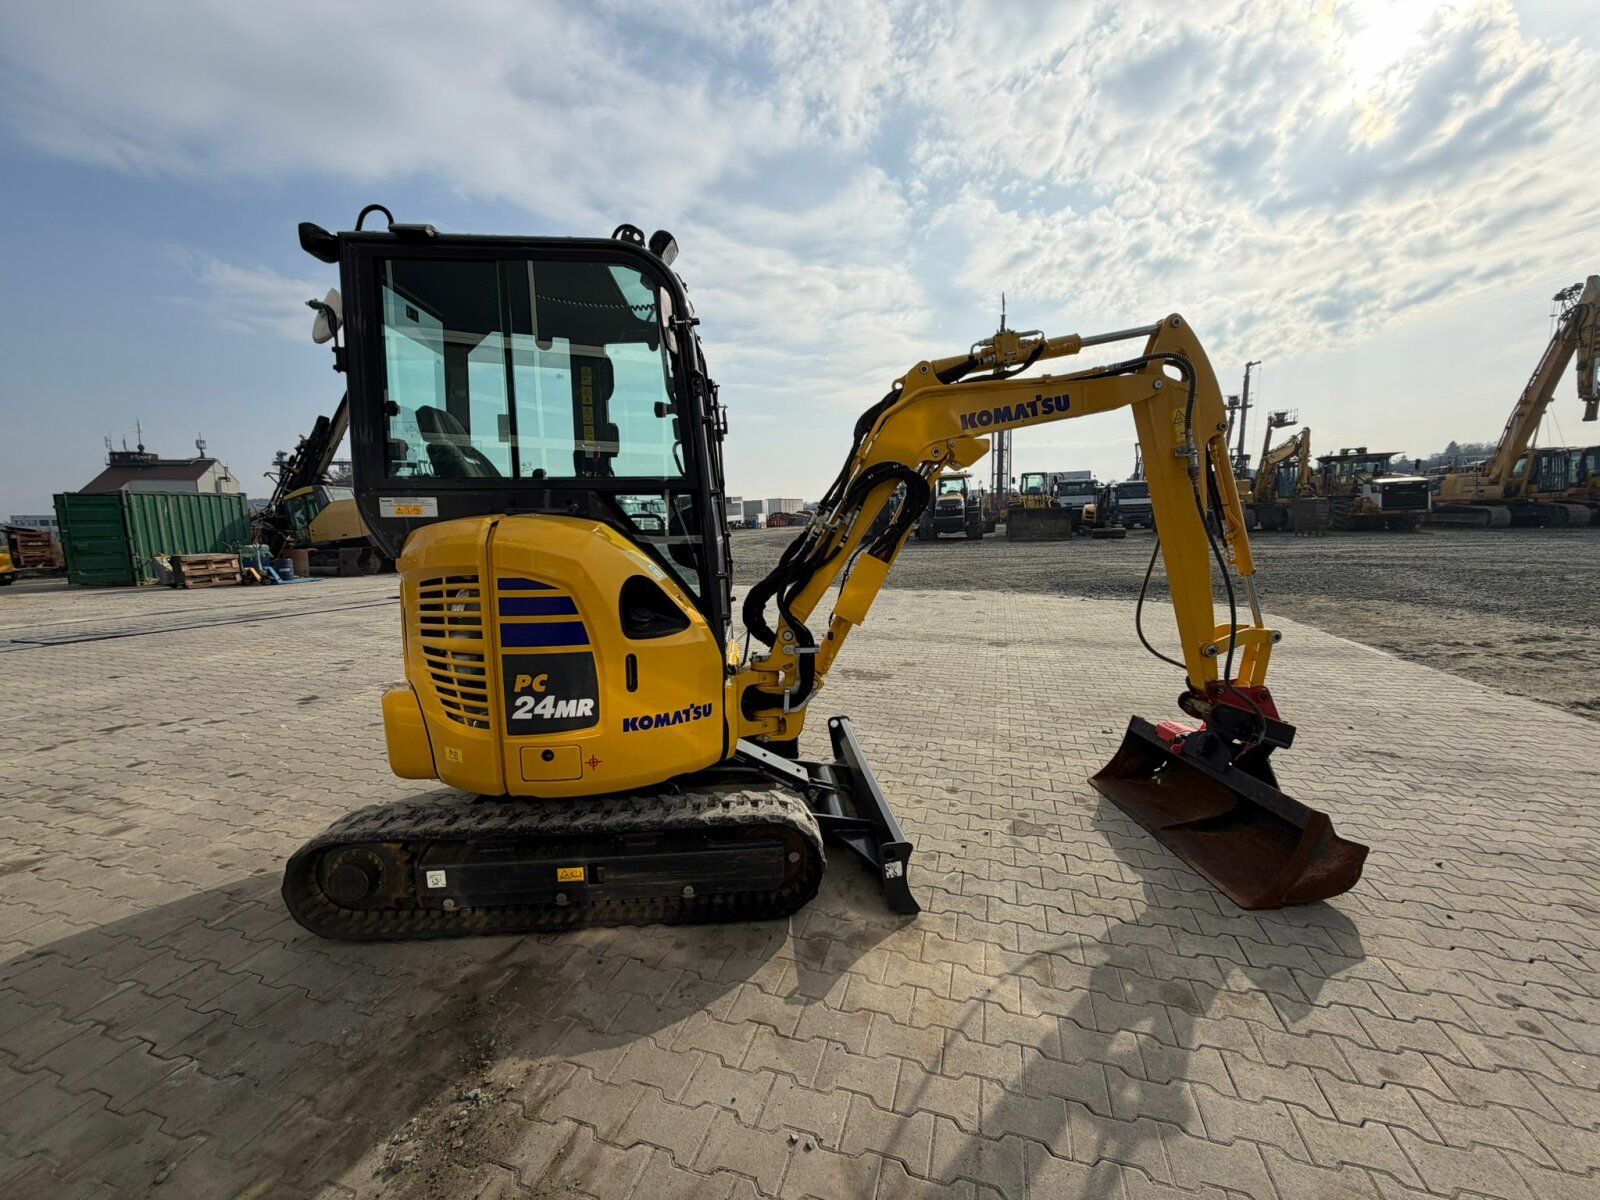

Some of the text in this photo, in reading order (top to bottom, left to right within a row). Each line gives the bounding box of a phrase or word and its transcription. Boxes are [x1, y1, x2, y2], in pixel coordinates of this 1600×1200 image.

[960, 394, 1071, 430] KOMATSU
[514, 674, 548, 693] PC
[511, 695, 595, 719] 24MR
[623, 703, 712, 732] KOMATSU
